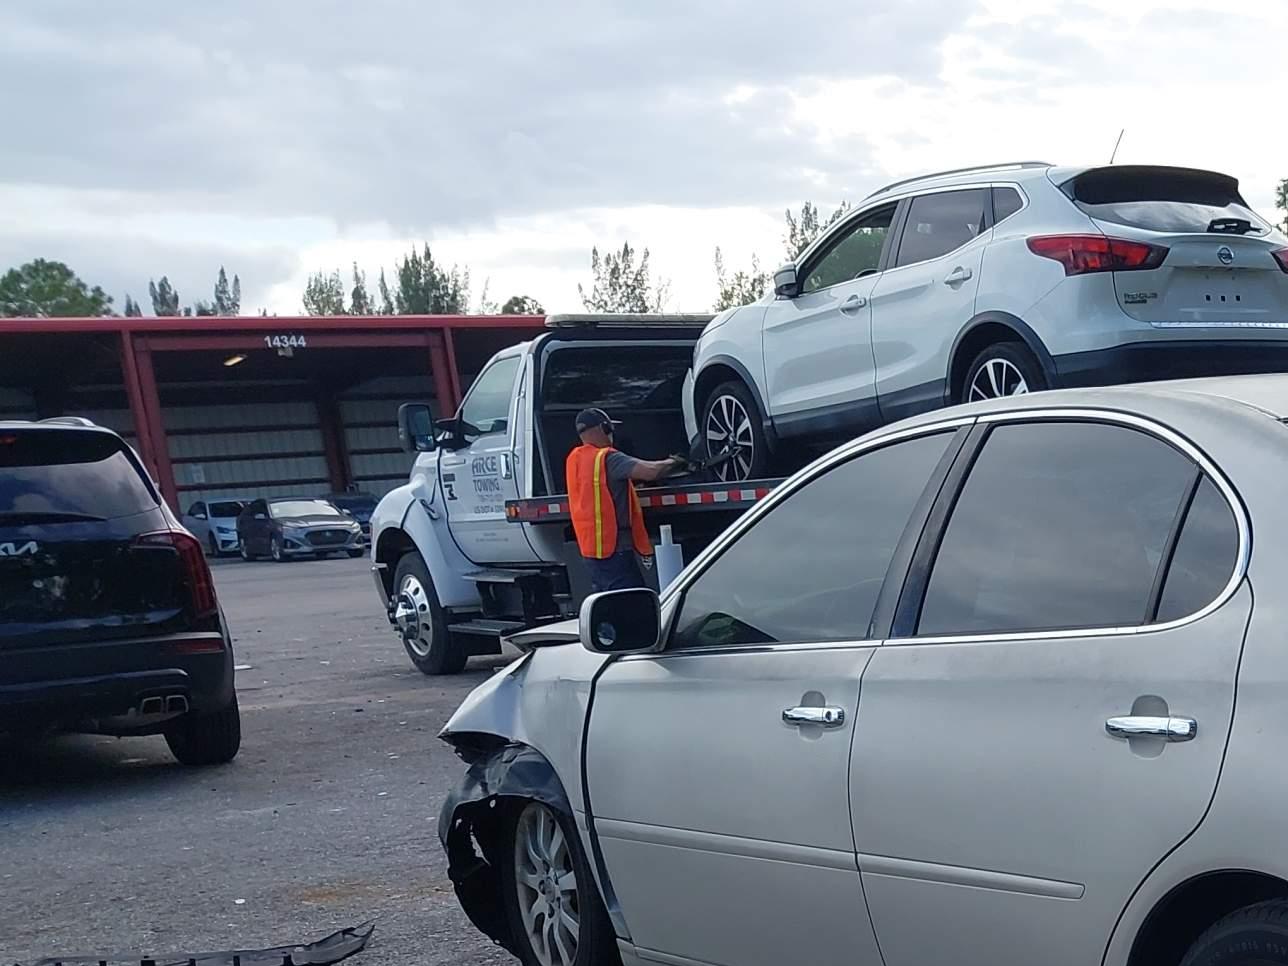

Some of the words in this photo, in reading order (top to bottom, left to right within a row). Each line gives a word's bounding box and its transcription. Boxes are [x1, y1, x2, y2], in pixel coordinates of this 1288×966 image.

[264, 335, 307, 348] 14344
[472, 456, 497, 474] ARCE
[473, 479, 500, 493] TOWING
